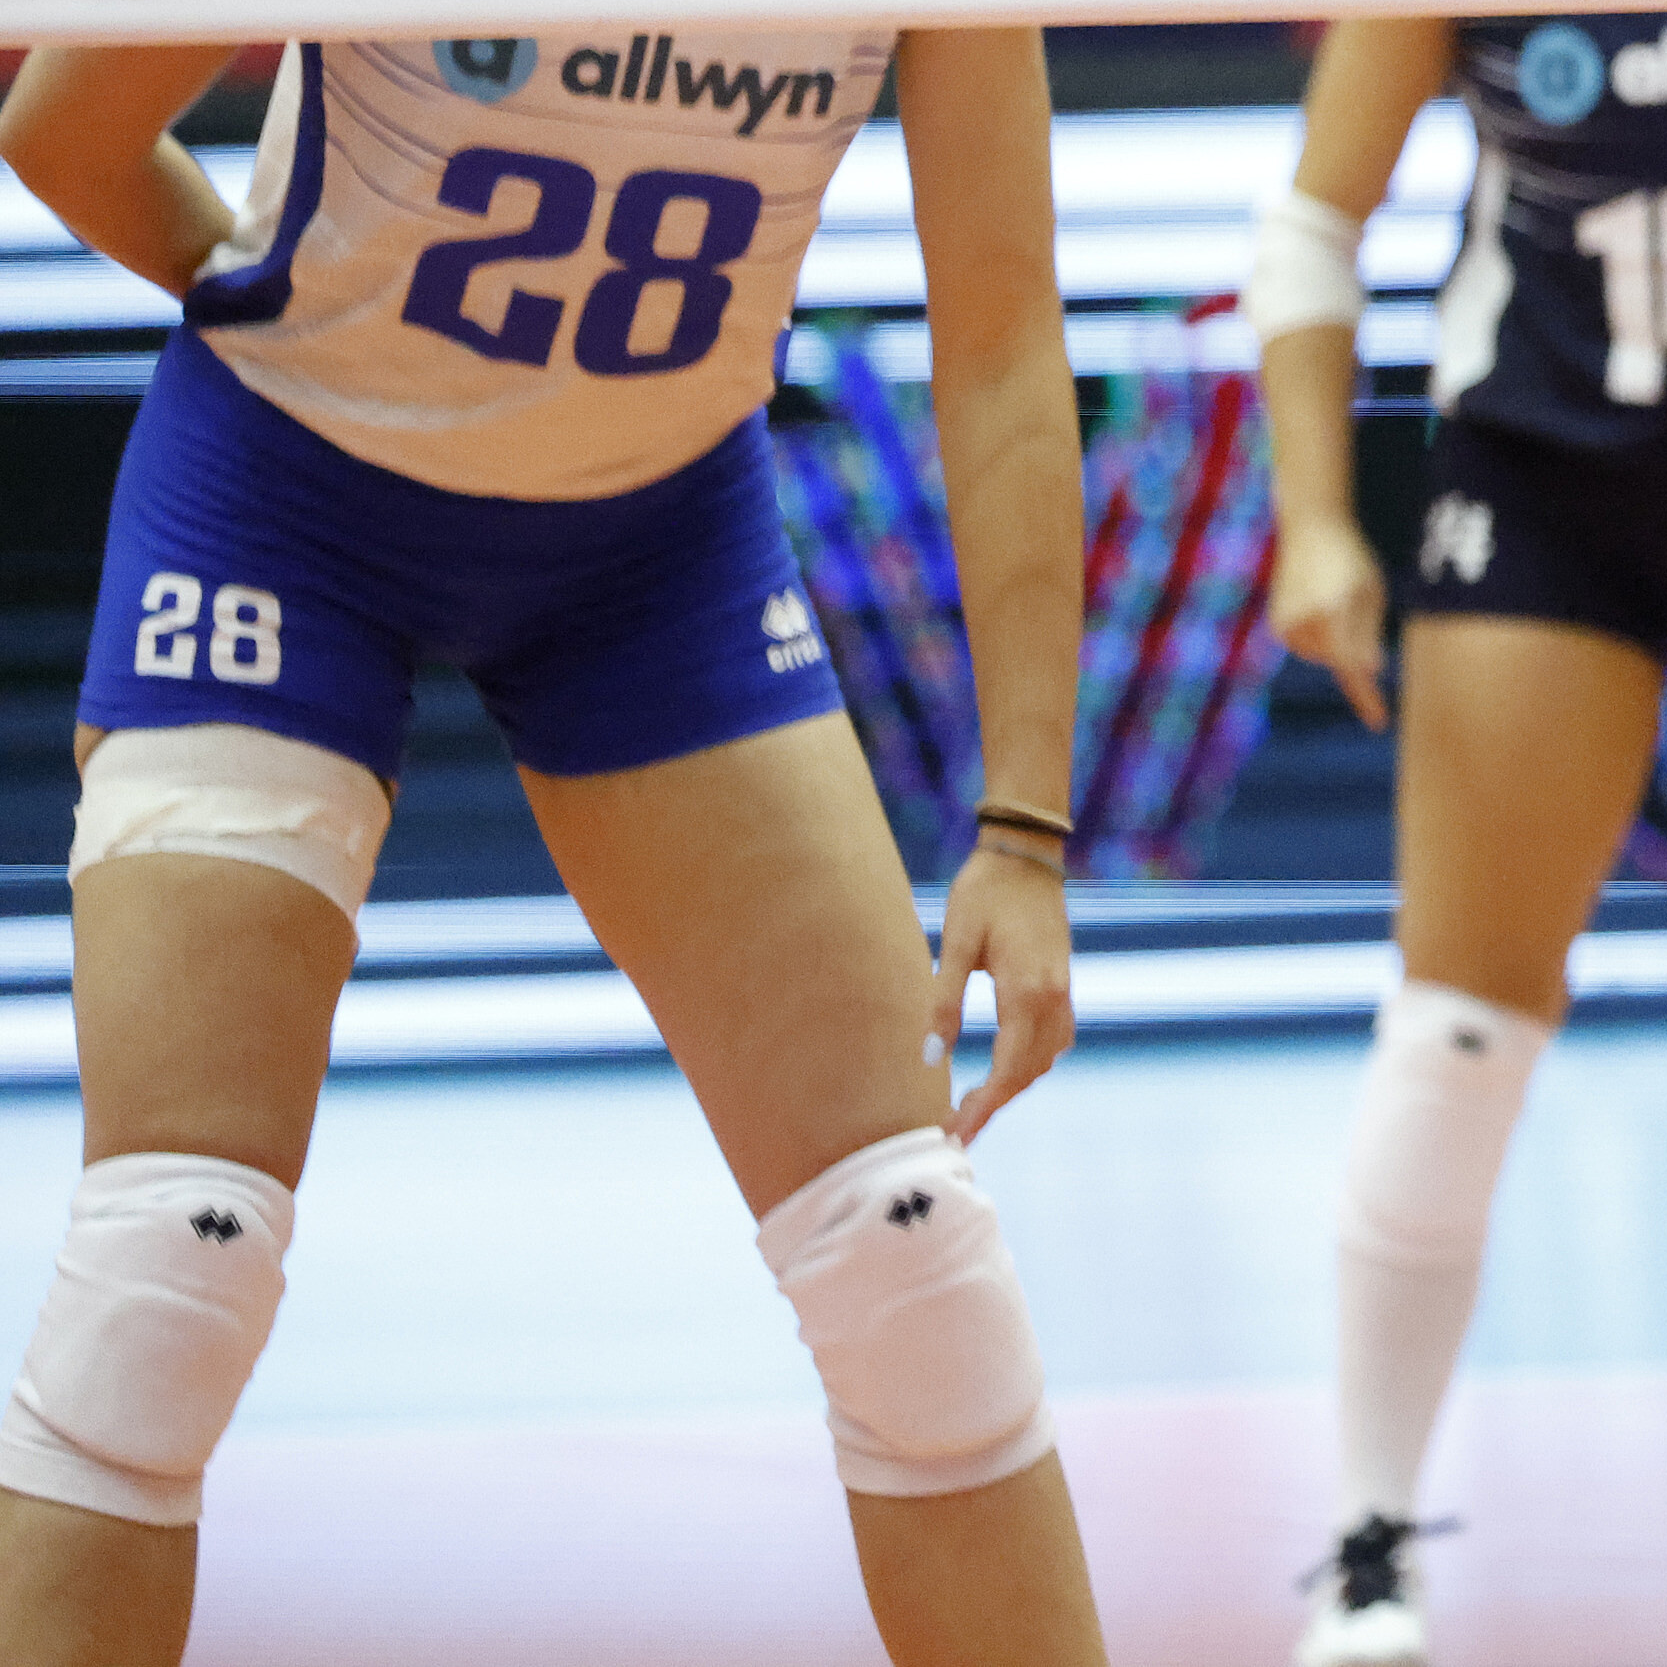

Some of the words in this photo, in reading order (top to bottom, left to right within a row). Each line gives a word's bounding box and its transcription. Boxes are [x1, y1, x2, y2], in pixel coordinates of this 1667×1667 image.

[560, 35, 836, 137] allwyn
[401, 147, 763, 376] 28
[133, 571, 282, 686] 28
